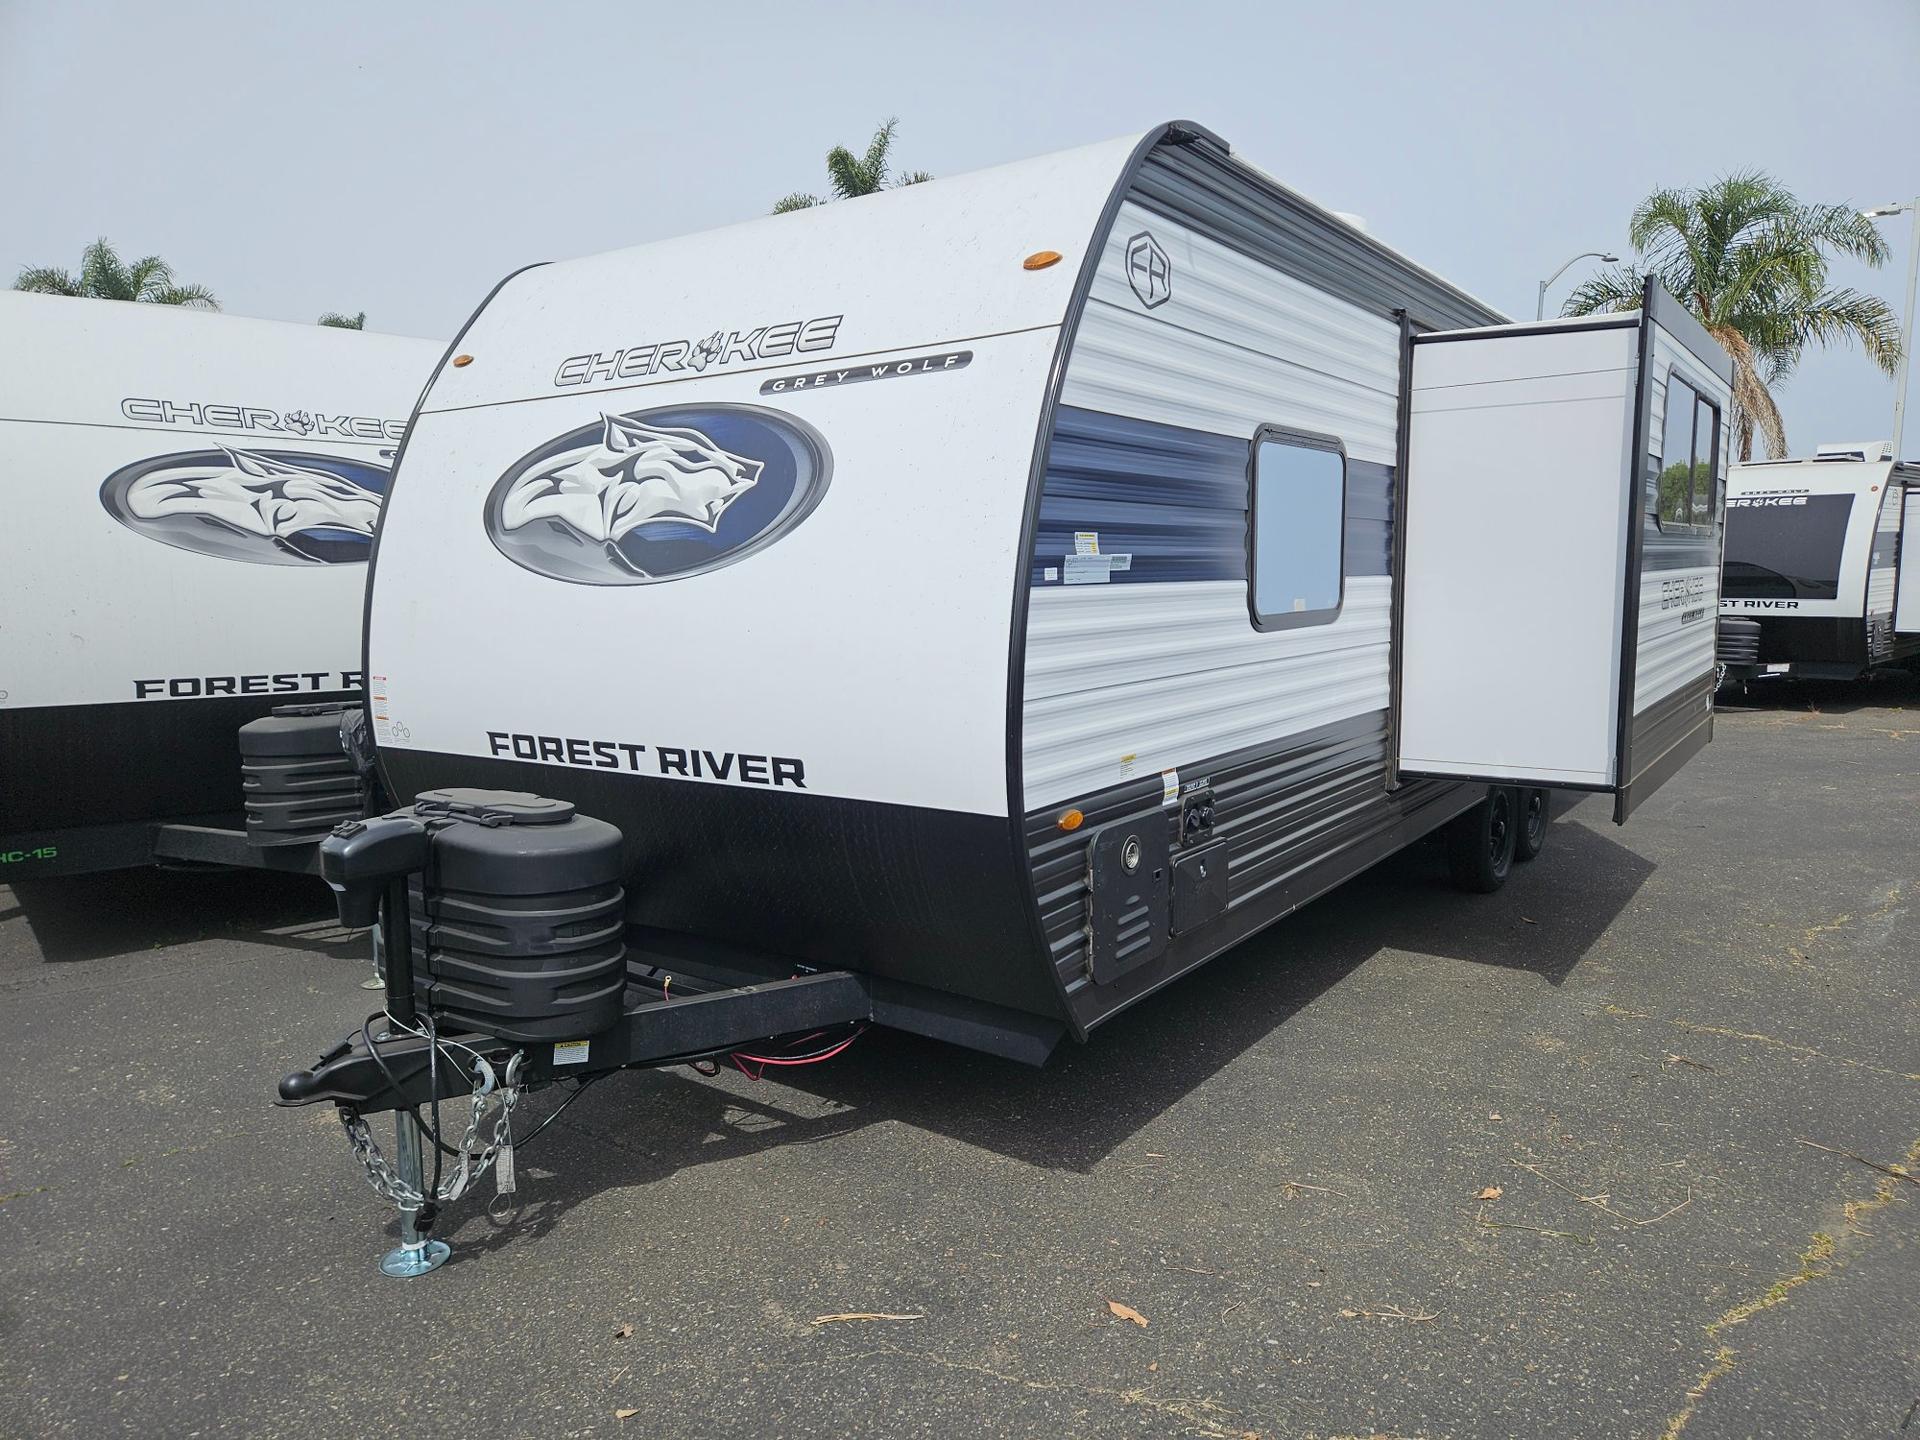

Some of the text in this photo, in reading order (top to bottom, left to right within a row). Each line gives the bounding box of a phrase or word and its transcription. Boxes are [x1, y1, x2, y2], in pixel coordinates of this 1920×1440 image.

[771, 354, 962, 392] GREY WOLF
[1726, 496, 1808, 508] EROKEE
[1744, 600, 1799, 609] RIVER
[132, 672, 330, 699] FOREST
[486, 731, 808, 789] FOREST RIVER
